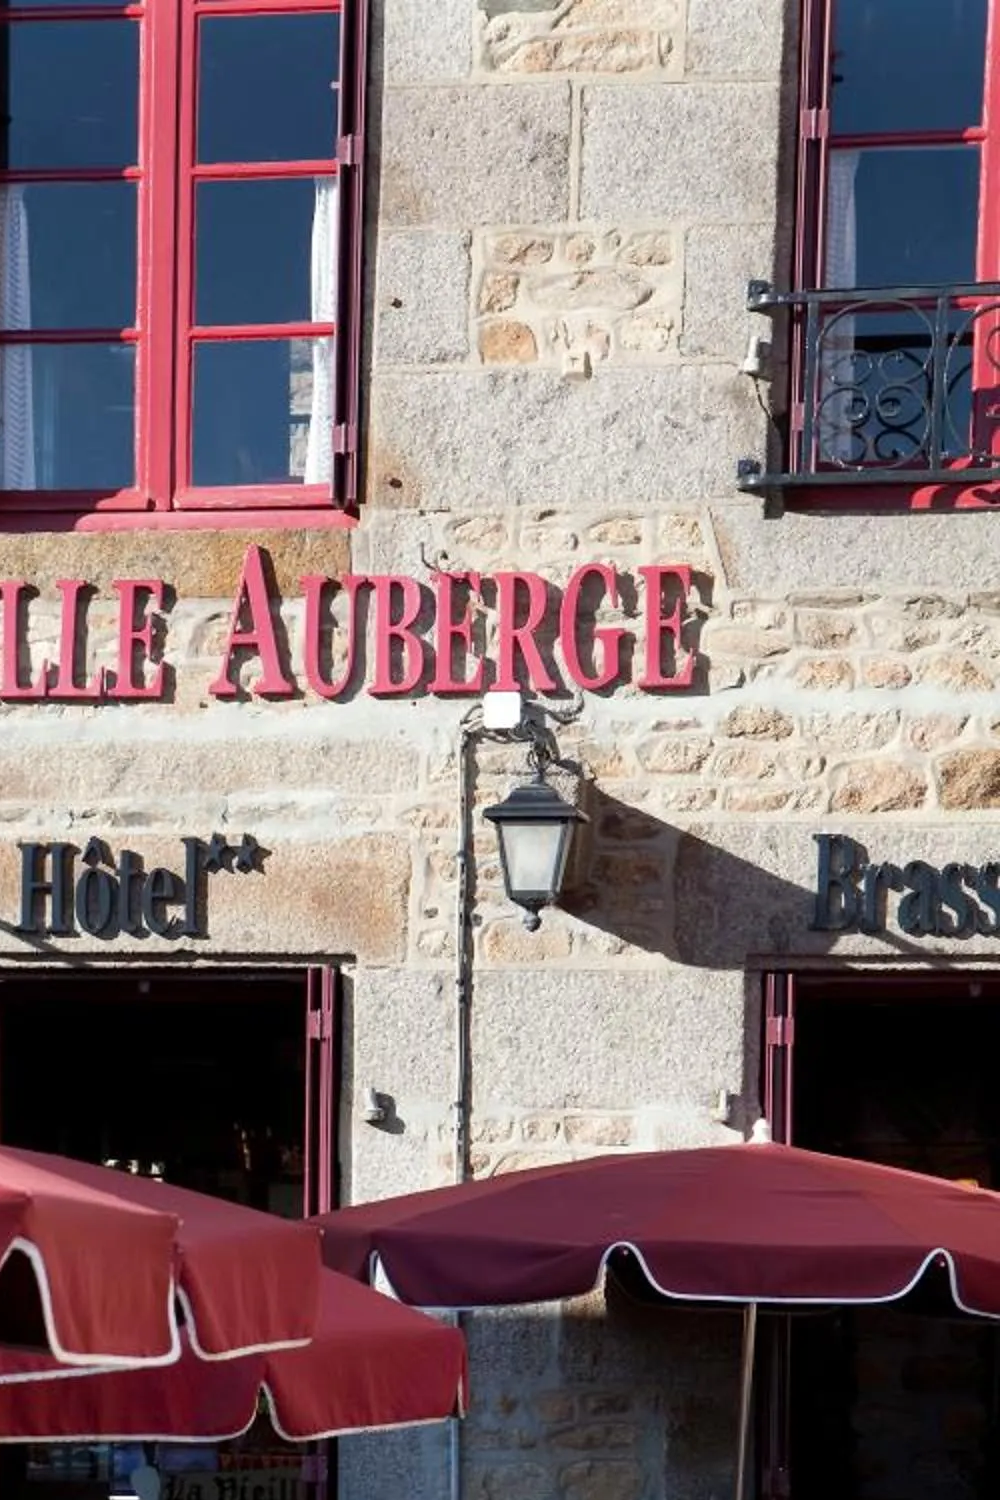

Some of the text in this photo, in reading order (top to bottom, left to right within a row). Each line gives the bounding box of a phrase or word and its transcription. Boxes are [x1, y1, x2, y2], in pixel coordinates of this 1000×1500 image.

[209, 543, 695, 699] AUBERGE
[15, 835, 207, 938] Hôtel
[808, 833, 1000, 937] Brass
